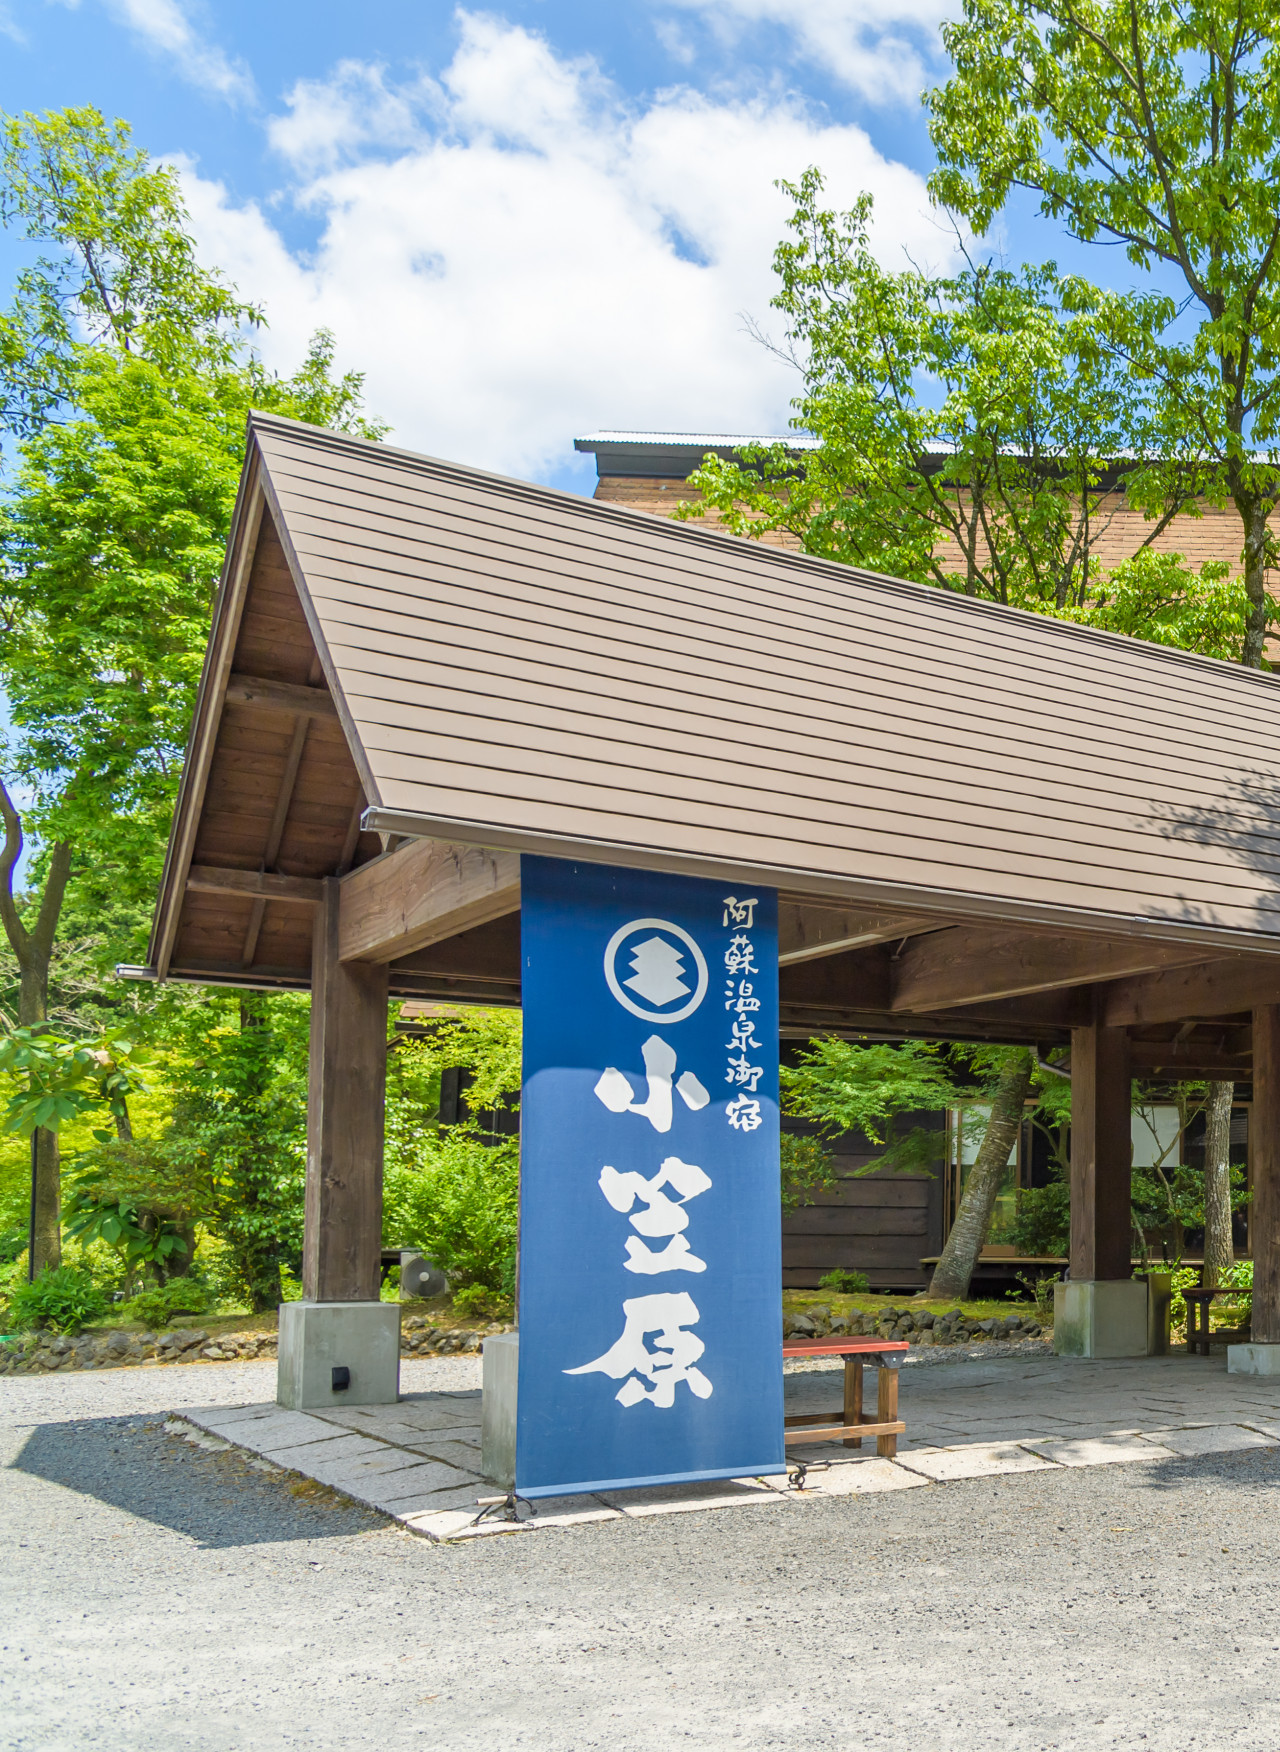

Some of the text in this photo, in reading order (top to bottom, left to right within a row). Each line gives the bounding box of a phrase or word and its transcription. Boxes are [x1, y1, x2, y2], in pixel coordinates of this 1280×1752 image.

[722, 896, 764, 1132] 阿蘇温泉御宿
[562, 1034, 713, 1409] 小笠原
